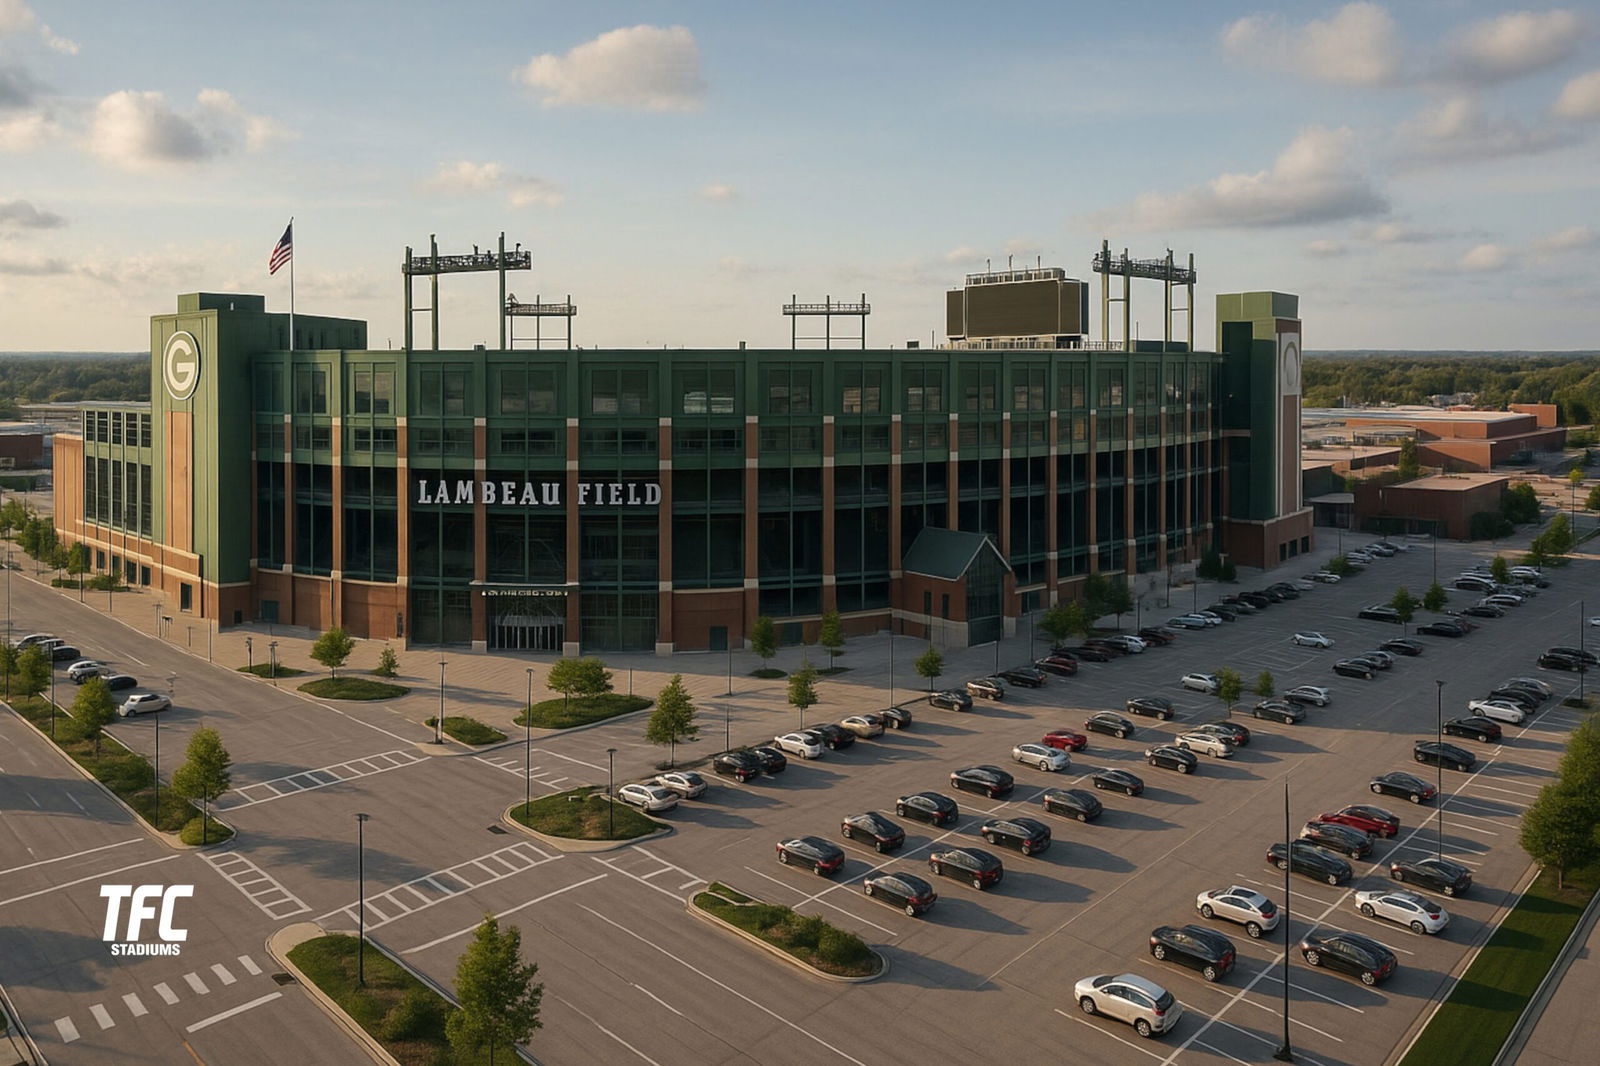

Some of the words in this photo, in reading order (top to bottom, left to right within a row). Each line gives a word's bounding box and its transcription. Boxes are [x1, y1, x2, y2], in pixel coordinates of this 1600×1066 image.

[166, 339, 196, 392] G
[417, 480, 560, 506] LAMBEAU
[577, 483, 662, 506] FIELD
